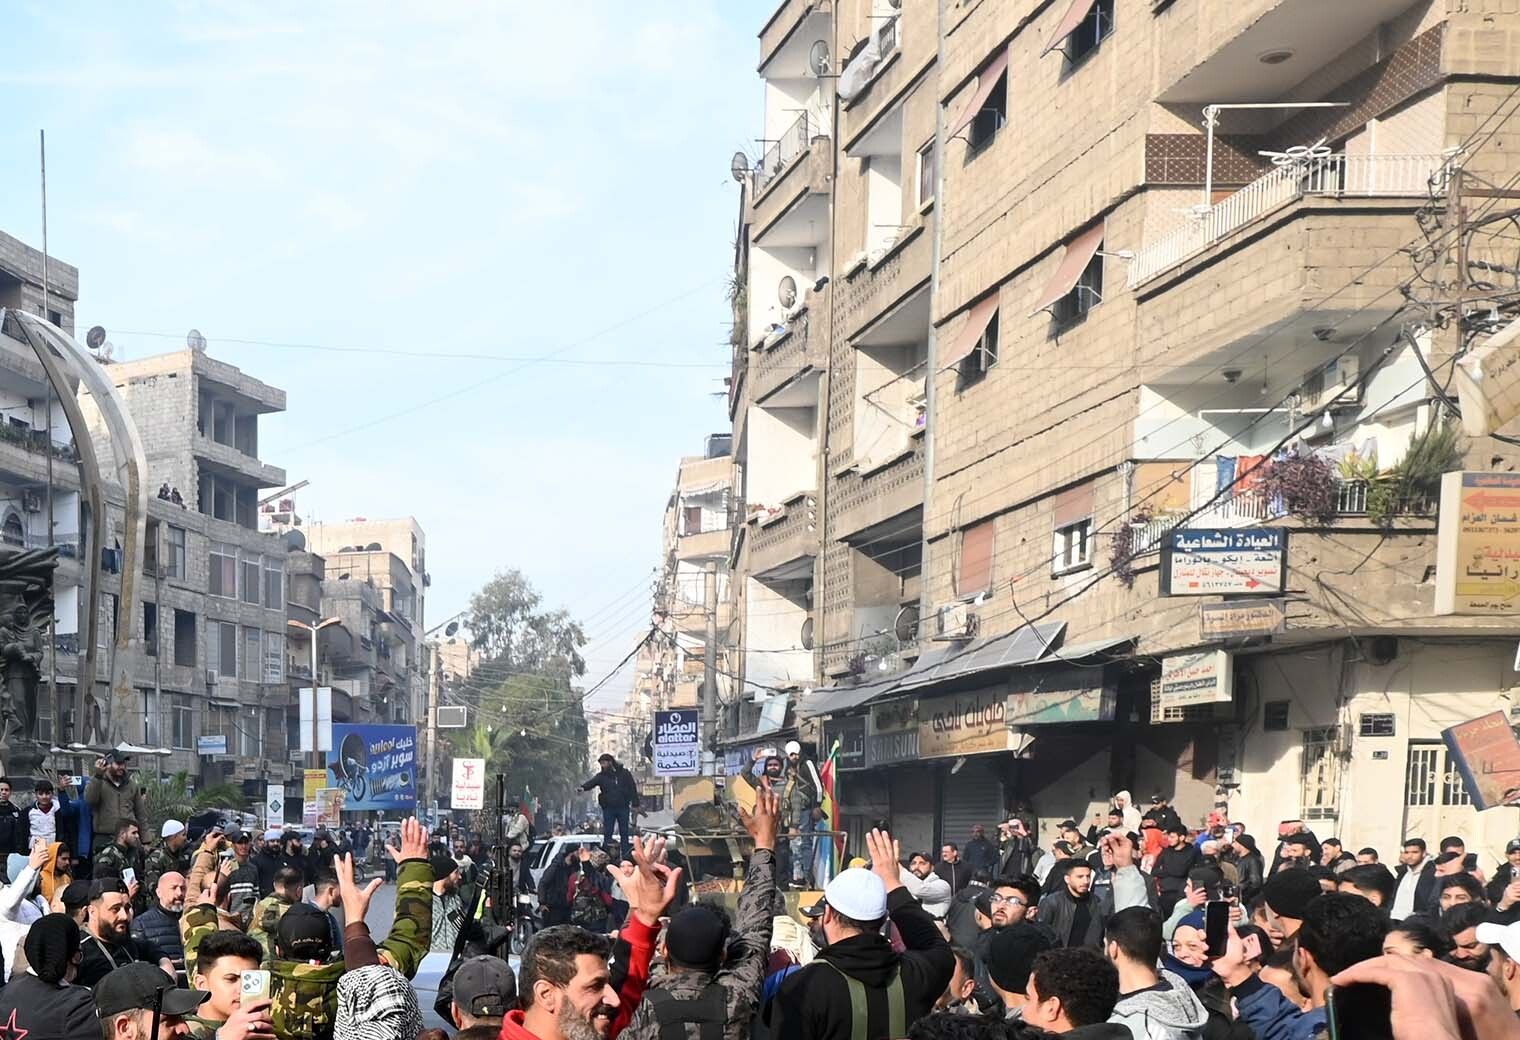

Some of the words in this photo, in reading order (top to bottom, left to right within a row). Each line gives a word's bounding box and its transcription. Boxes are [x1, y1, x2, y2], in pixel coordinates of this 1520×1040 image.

[1176, 531, 1233, 553] الشعاعية
[1235, 533, 1279, 550] العيادة
[658, 722, 696, 735] العطار
[658, 733, 696, 744] alattar
[390, 750, 414, 769] سوبر
[657, 750, 686, 758] صيدلية
[657, 760, 696, 770] الحكمة
